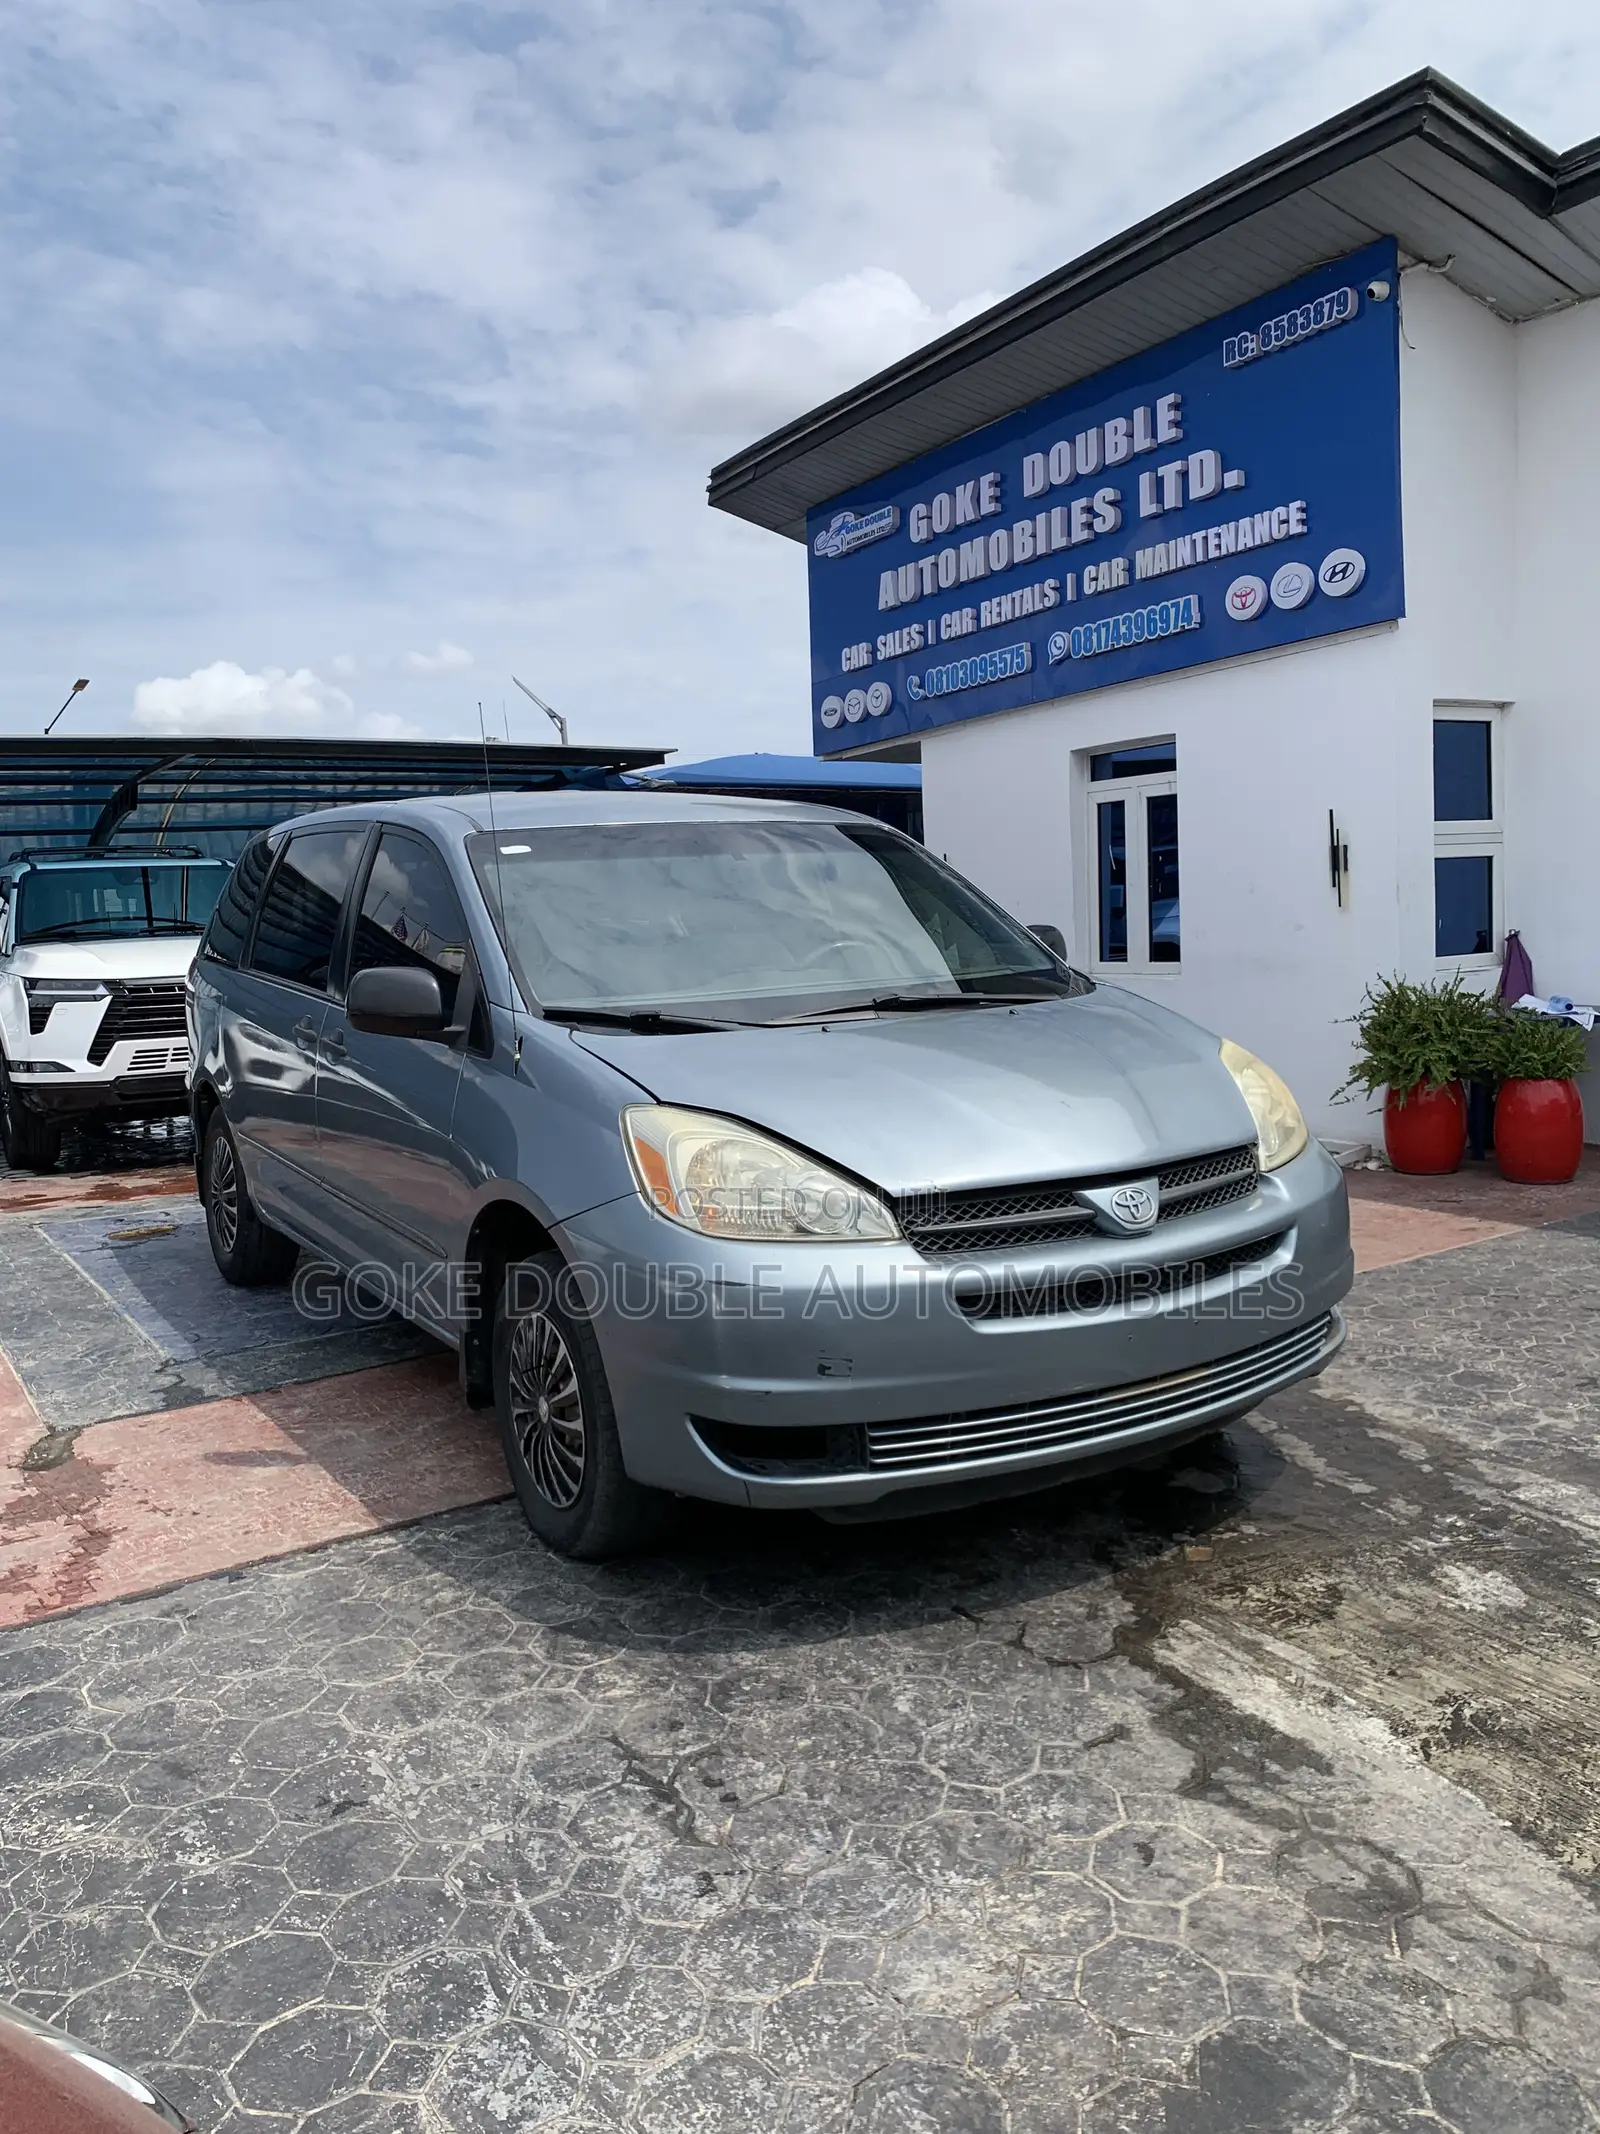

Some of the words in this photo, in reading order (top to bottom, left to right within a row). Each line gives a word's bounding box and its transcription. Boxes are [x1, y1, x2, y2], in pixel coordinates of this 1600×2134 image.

[1223, 331, 1259, 367] RC:
[1260, 287, 1354, 351] 8583879
[909, 472, 1001, 543] GOKE
[1023, 392, 1183, 498] DOUBLE
[844, 521, 864, 534] GOKE
[864, 507, 892, 527] DOUBLE
[878, 487, 1121, 610] AUTOMOBILES
[1139, 449, 1245, 518] LTD.
[841, 642, 872, 672] CAR
[877, 623, 924, 660] SALES
[940, 607, 977, 640] CAR
[980, 578, 1060, 628] RENTALS
[1083, 557, 1129, 595] CAR
[1135, 500, 1307, 580] MAINTENANCE
[1070, 595, 1195, 658] 08174396974
[924, 642, 1028, 697] 08103095575
